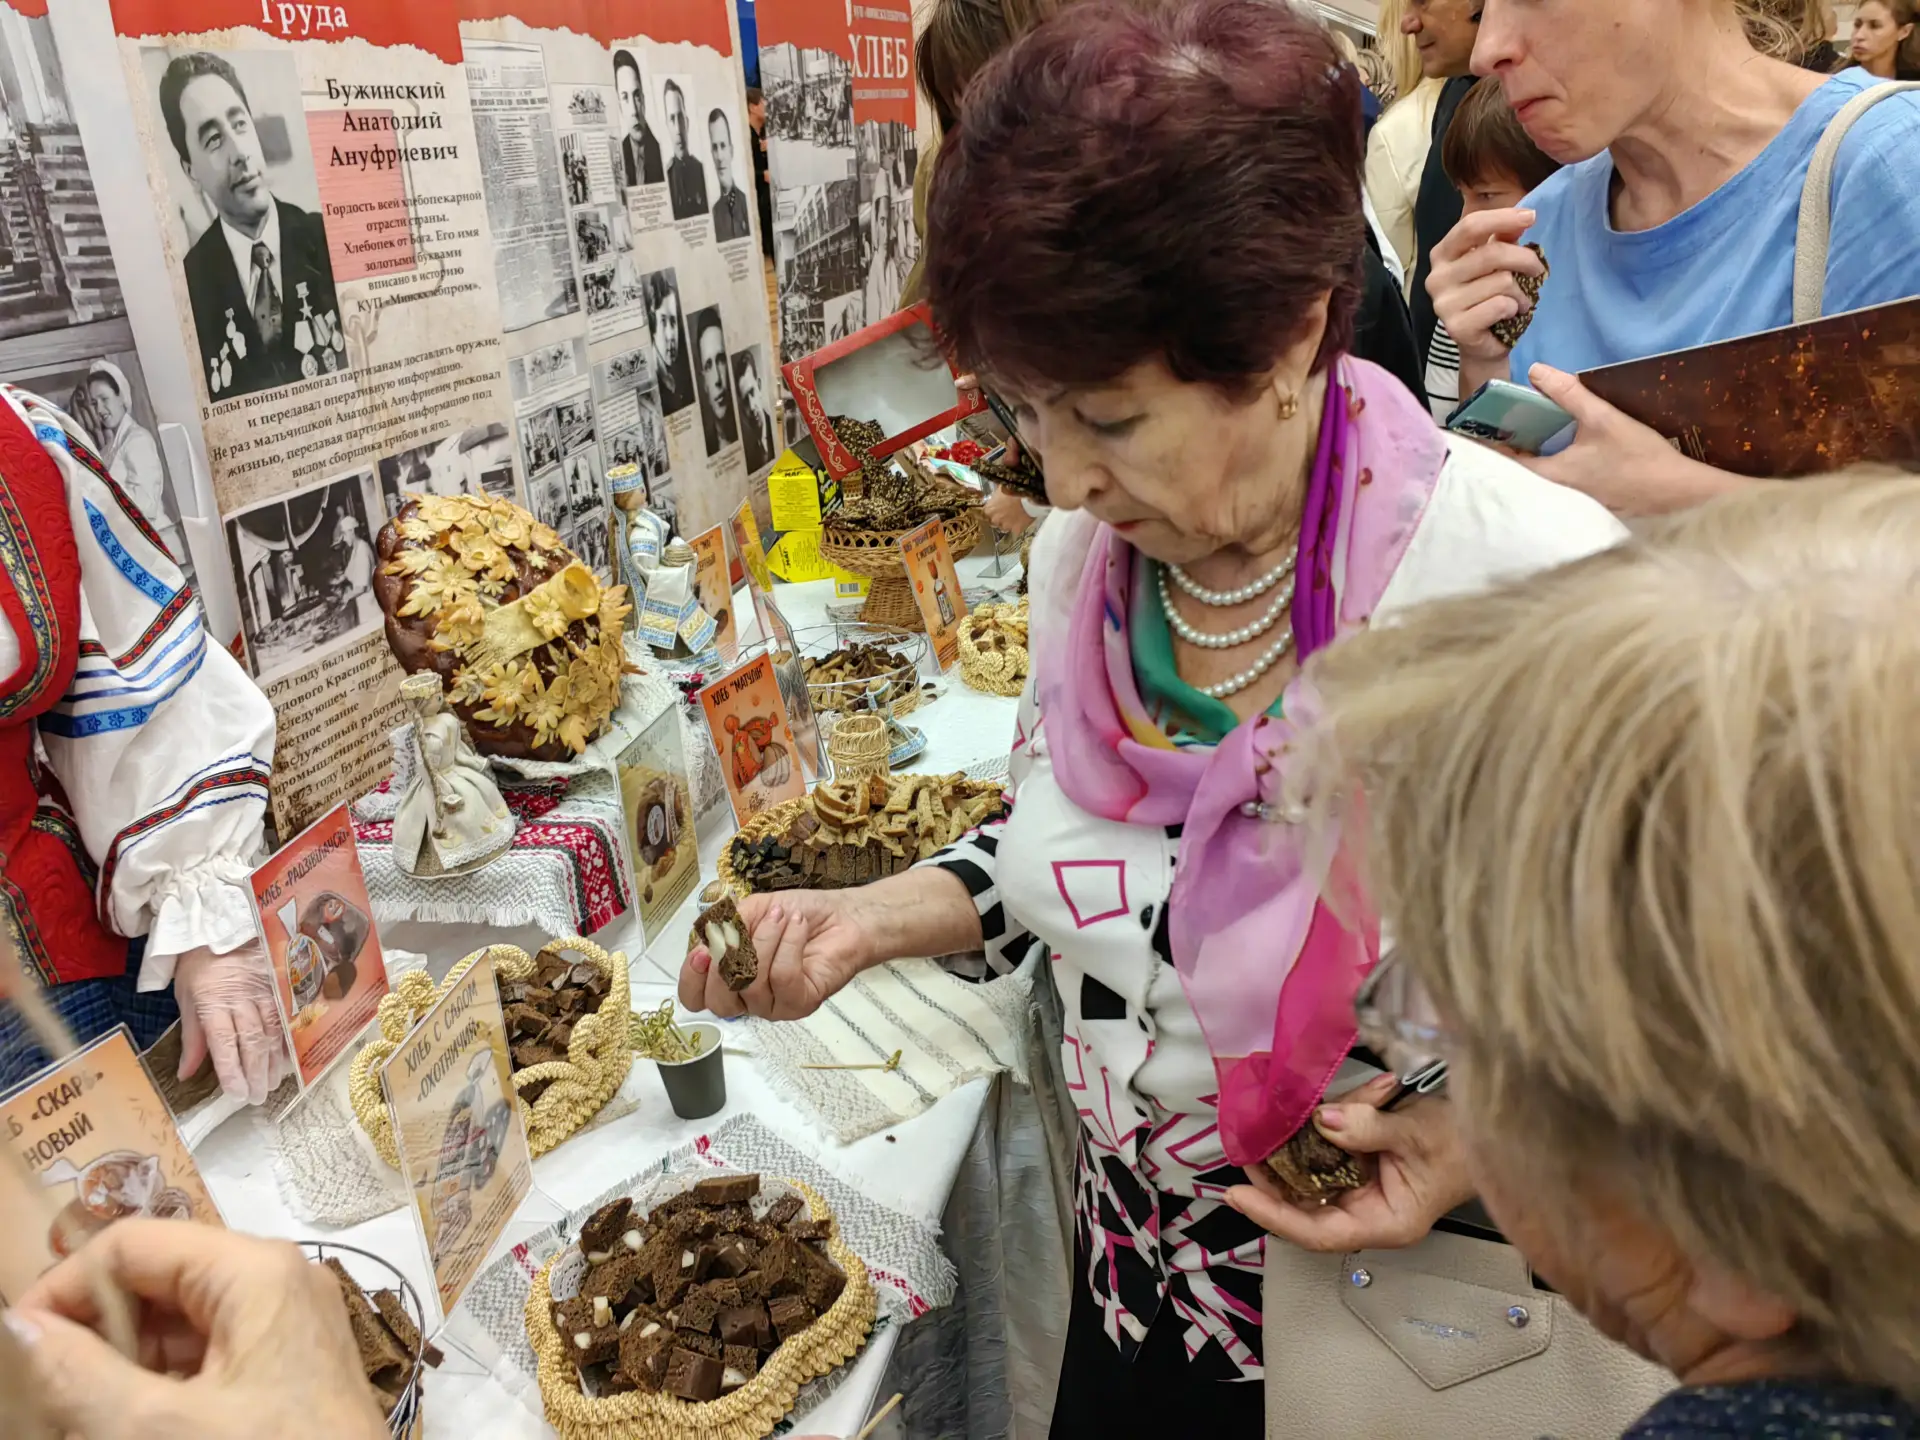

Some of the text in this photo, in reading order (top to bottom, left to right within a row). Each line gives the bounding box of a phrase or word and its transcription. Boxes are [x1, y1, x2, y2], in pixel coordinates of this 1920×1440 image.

[848, 33, 909, 78] ХЛЕБ
[326, 78, 446, 107] Бужинский
[343, 111, 443, 132] Анатолий
[330, 143, 460, 171] Ануфриевич
[326, 191, 482, 218] Гордость всей хлебопекарной
[344, 239, 396, 254] Хлебопек
[397, 237, 408, 247] от
[410, 233, 434, 245] Бога.
[435, 230, 455, 241] Его
[457, 228, 480, 238] имя
[366, 214, 450, 233] отрасли страны.
[365, 249, 462, 272] золотыми буквами
[368, 266, 464, 290] вписано в историю
[357, 297, 382, 313] КУП
[202, 337, 501, 420] В годы войны помогал партизанам доставлять оружие,
[247, 362, 464, 428] и передавал оперативную информацию.
[213, 371, 501, 461] Не раз мальчишкой Анатолий Ануфриевич рисковал
[227, 454, 285, 478] жизнью,
[287, 437, 343, 460] передавая
[346, 416, 406, 440] партизанам
[408, 395, 470, 420] информацию
[472, 389, 493, 402] под
[291, 420, 452, 479] видом сборщика грибов и ягод.
[266, 679, 292, 700] 1971
[295, 666, 320, 686] году
[322, 654, 345, 671] был
[274, 656, 377, 718] удового Красного
[357, 662, 401, 690] присвои
[711, 685, 730, 709] ХЛЕБ
[273, 702, 360, 755] очетное звание
[274, 731, 378, 795] промышленности
[380, 708, 409, 732] БССР
[277, 799, 285, 813] В
[288, 784, 313, 806] 1973
[315, 770, 339, 791] году
[344, 766, 375, 791] самой
[258, 880, 282, 910] ХЛЕБ
[404, 978, 478, 1078] ХЛЕБ С САЛОМ
[22, 1111, 94, 1171] НОВЫЙ
